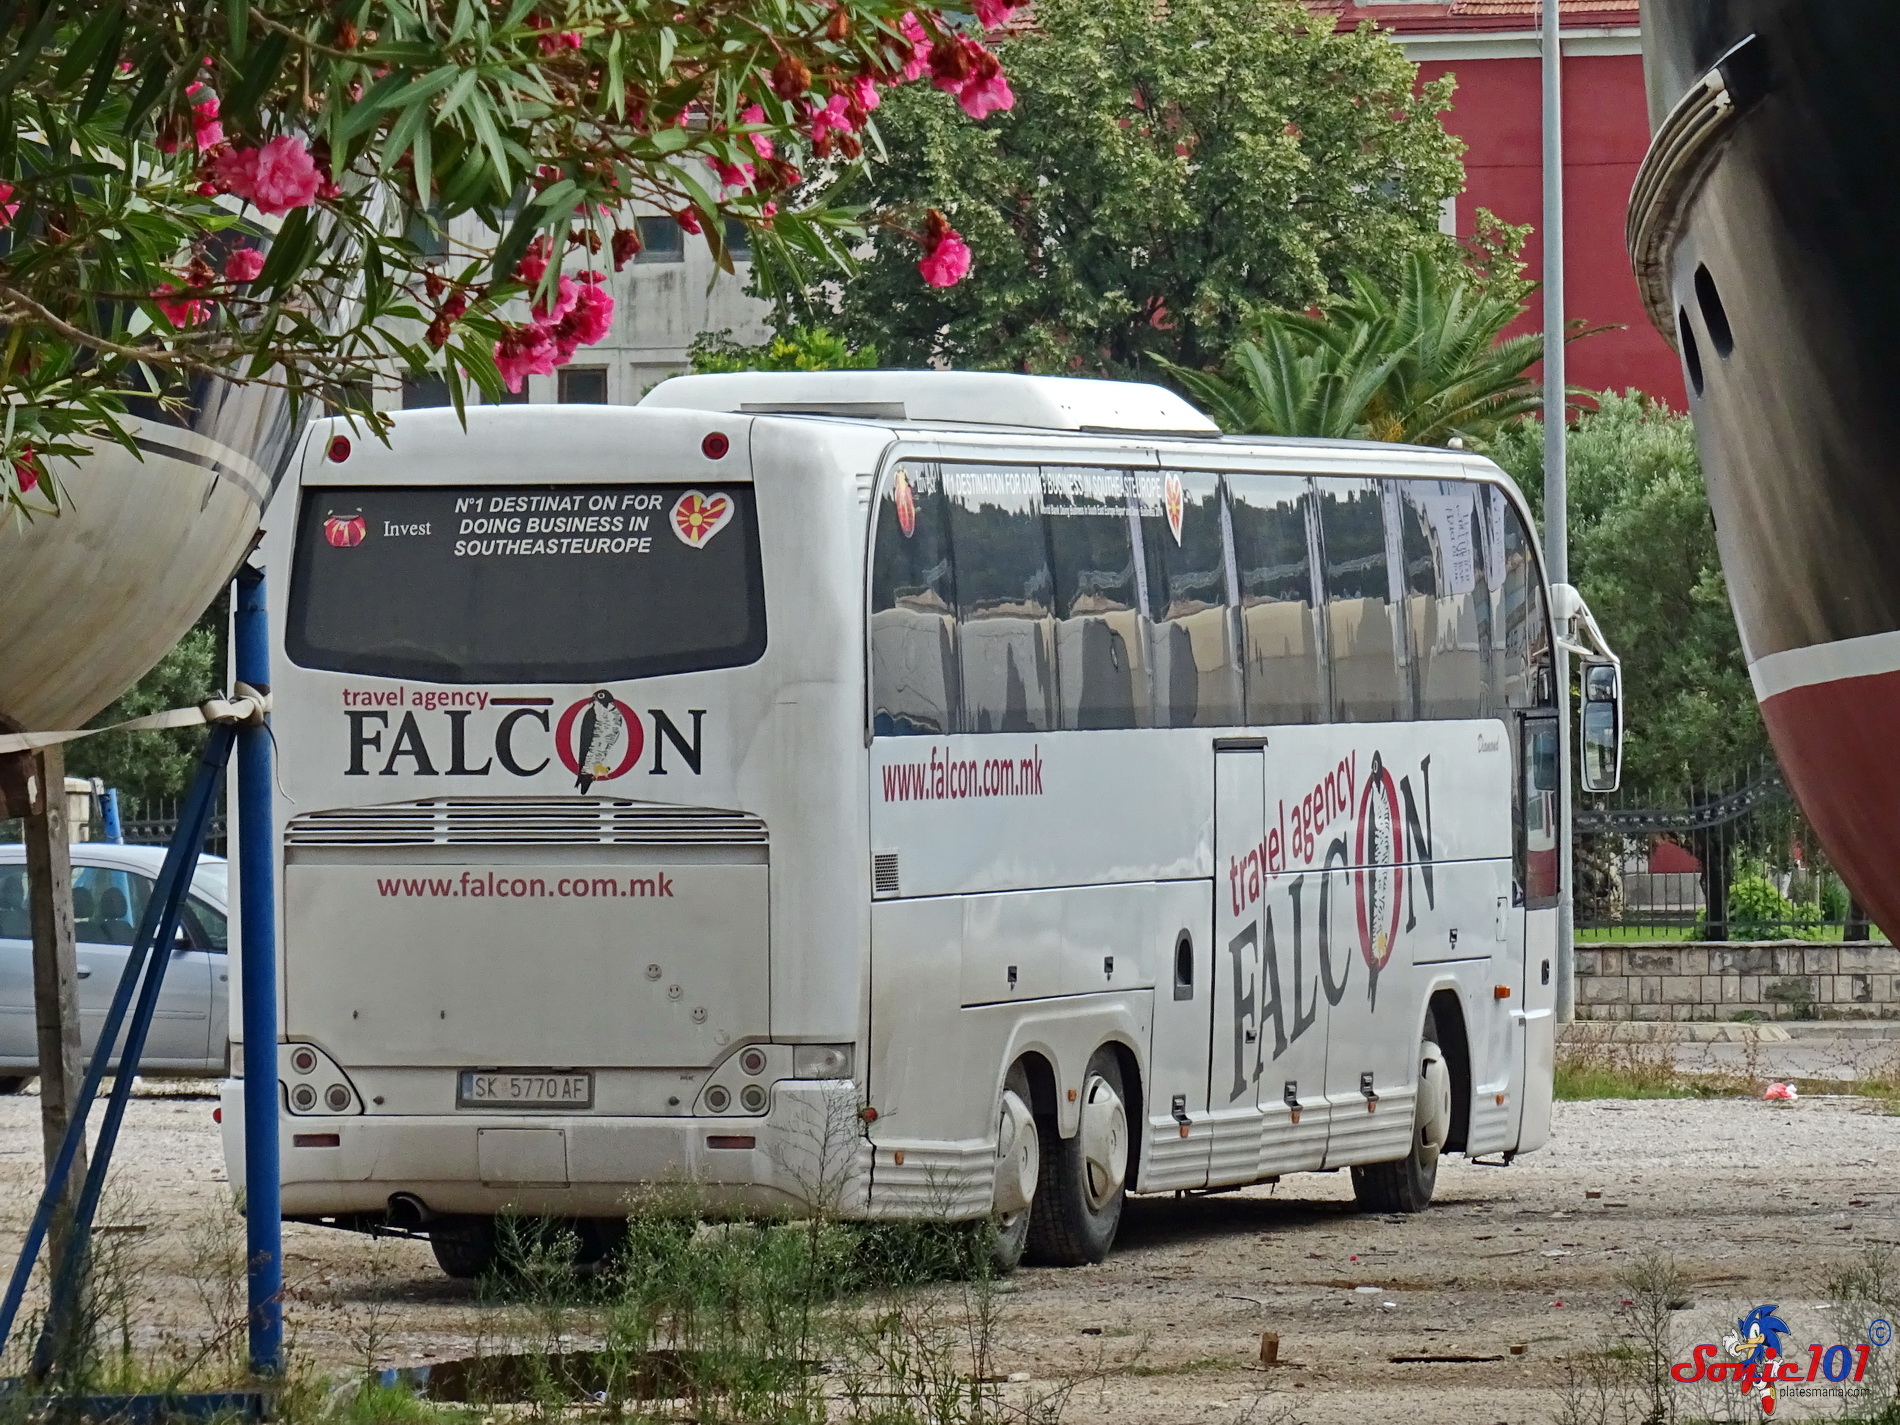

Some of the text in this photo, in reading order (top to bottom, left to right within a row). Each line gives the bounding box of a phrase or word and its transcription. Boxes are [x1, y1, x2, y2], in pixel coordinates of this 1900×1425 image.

[1006, 473, 1020, 494] FOR
[621, 494, 663, 510] FOR
[383, 520, 432, 537] Invest
[459, 516, 650, 534] DOING BUSINESS IN
[454, 537, 652, 556] SOUTHEASTEUROPE
[342, 686, 489, 710] travel agency
[343, 696, 708, 782] FALCON
[882, 743, 1044, 803] www.falcon.com.mk
[1229, 750, 1356, 918] travel agency
[376, 872, 675, 898] www.falcon.com.mk
[1228, 753, 1434, 1104] FALCON
[474, 1077, 498, 1098] SK
